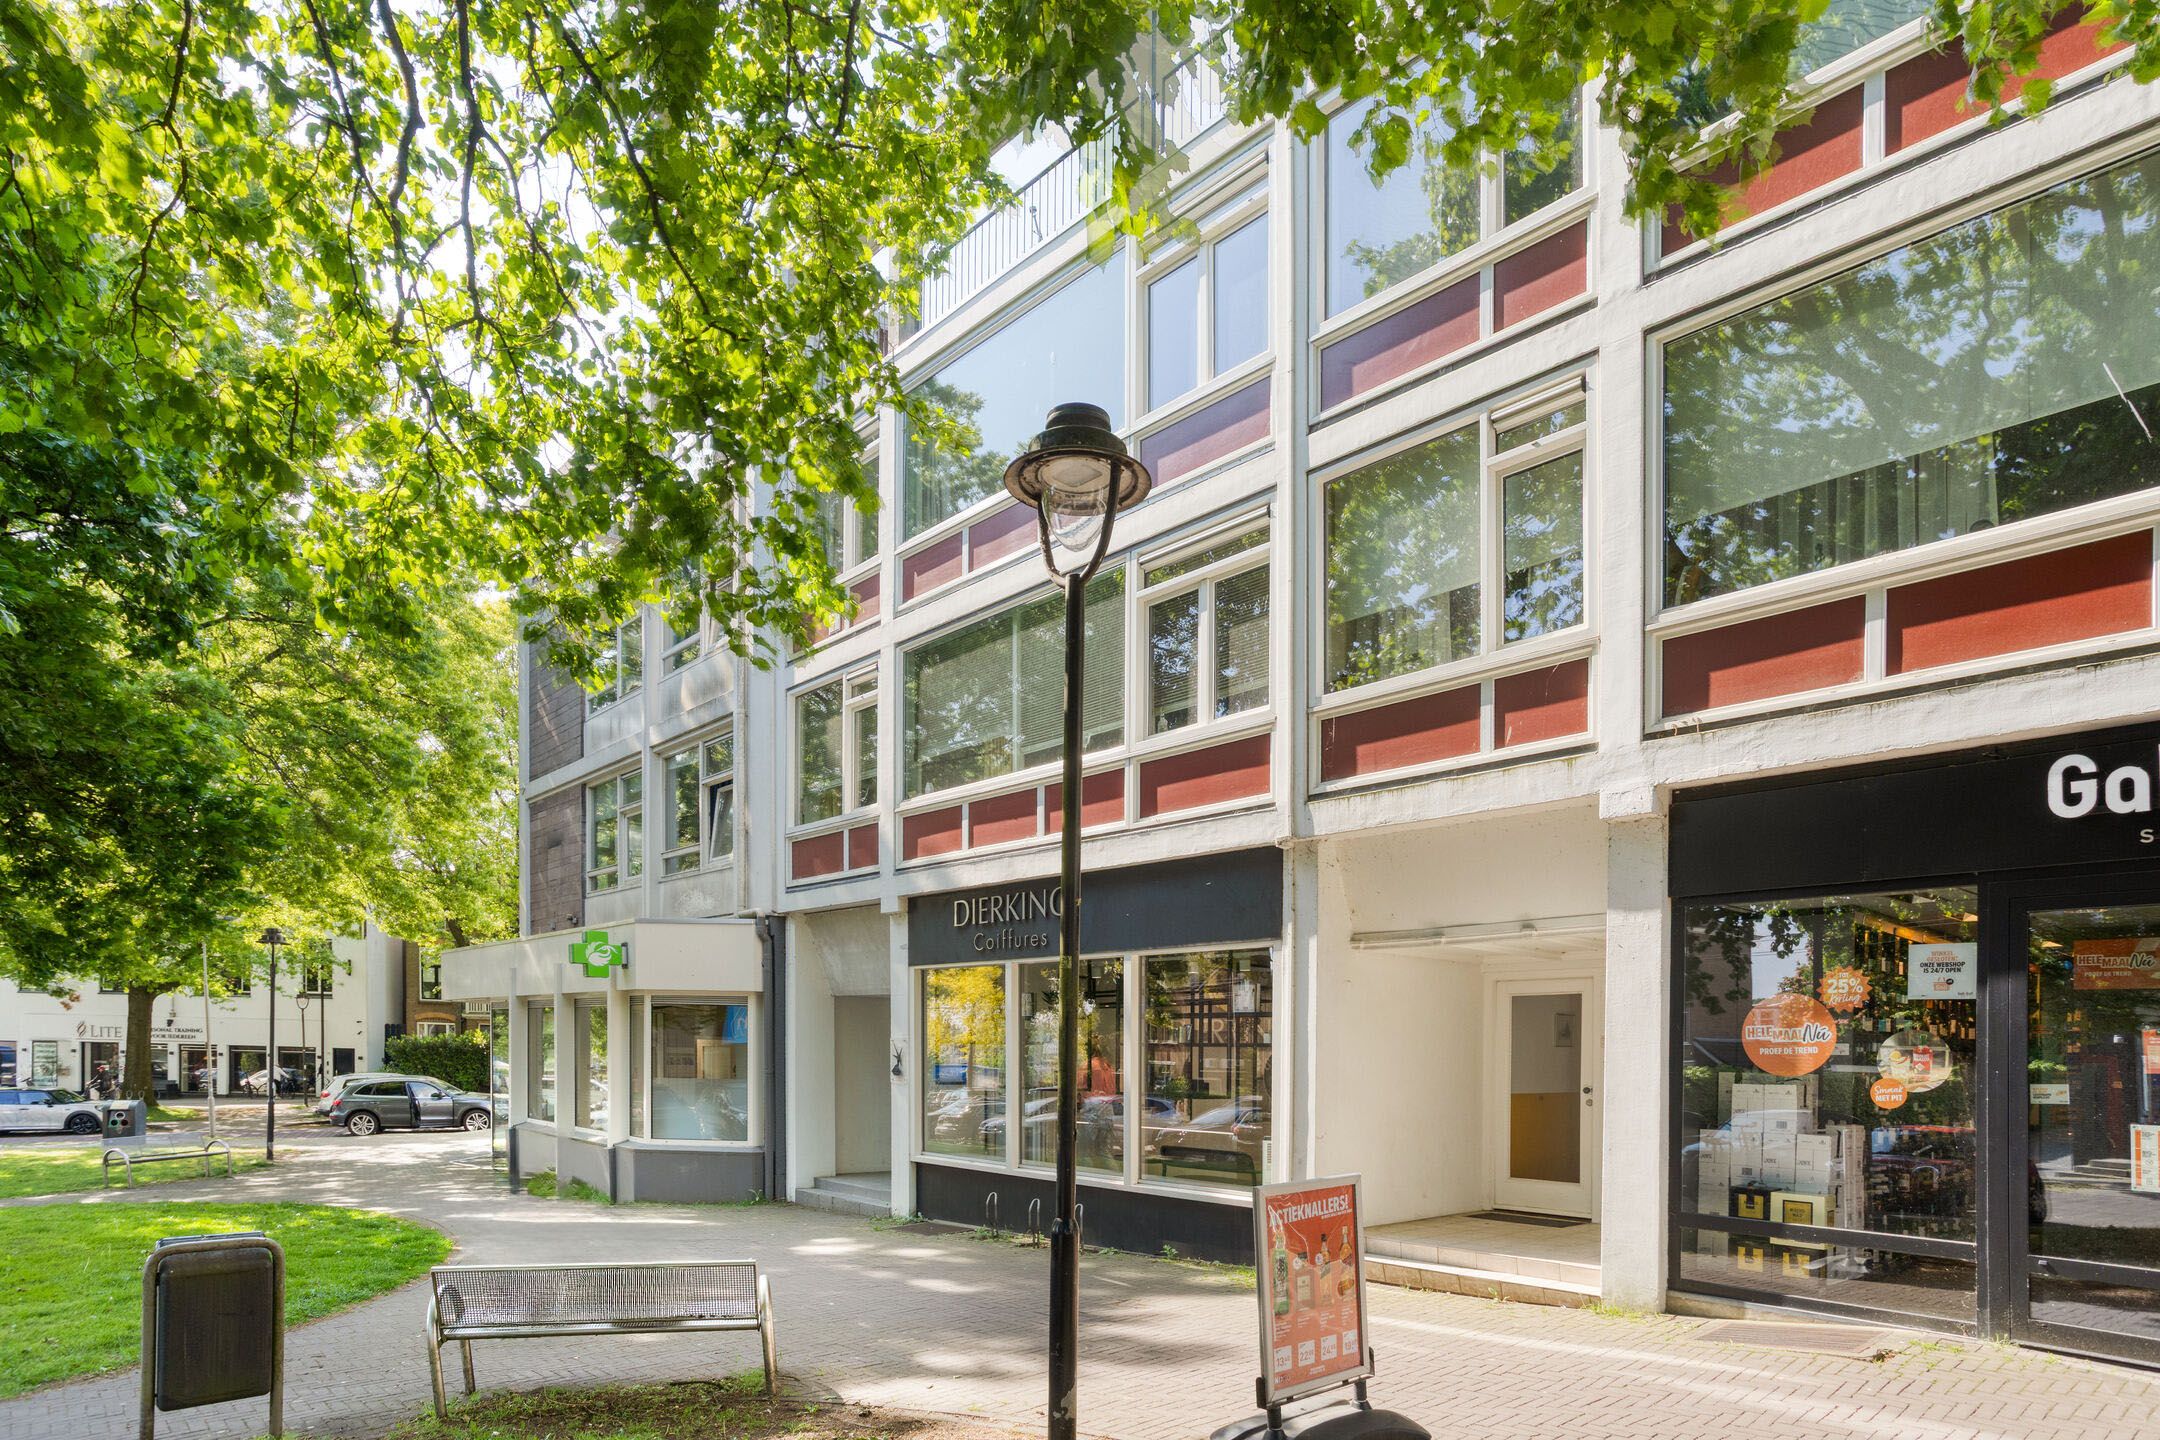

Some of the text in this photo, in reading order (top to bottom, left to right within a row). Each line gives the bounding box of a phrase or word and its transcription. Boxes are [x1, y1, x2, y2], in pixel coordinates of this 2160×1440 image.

[2047, 743, 2160, 818] Ga
[973, 928, 1048, 951] Coiffures
[1827, 978, 1864, 994] 25%
[90, 1024, 123, 1038] LITE
[1760, 1047, 1782, 1055] PROEF
[1794, 1046, 1819, 1054] TREND
[1874, 1085, 1904, 1095] Smaak
[1875, 1094, 1903, 1102] MET PIT
